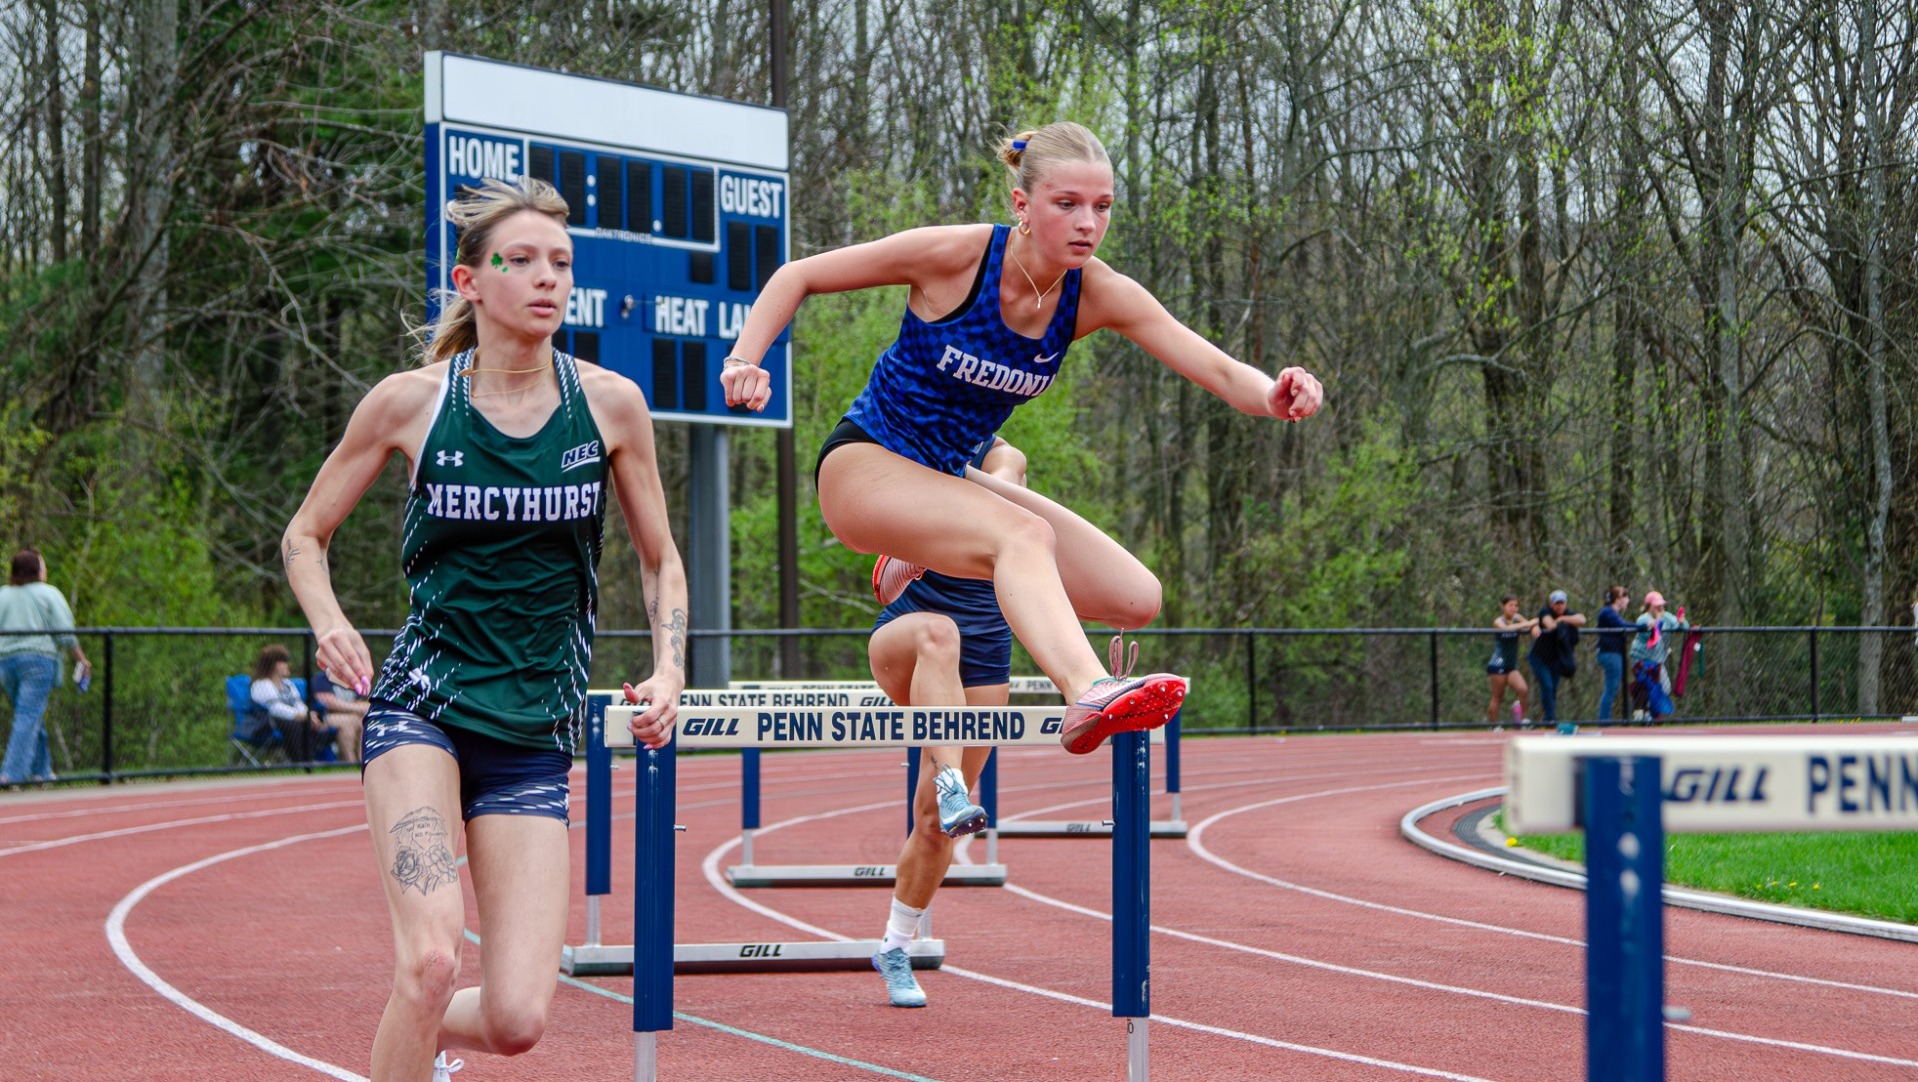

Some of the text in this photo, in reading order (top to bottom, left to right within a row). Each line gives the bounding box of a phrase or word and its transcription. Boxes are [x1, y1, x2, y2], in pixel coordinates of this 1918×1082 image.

[449, 135, 519, 183] HOME
[720, 175, 783, 218] GUEST
[564, 287, 607, 327] ENT
[655, 295, 709, 336] HEAT
[936, 344, 1056, 397] FREDONI
[561, 440, 599, 468] NEC
[426, 481, 601, 522] MERCYHURST
[679, 693, 712, 706] ENN
[718, 693, 767, 706] STATE
[772, 693, 850, 706] BEHREND
[682, 718, 740, 736] GILL
[757, 711, 823, 741] PENN
[831, 711, 904, 741] STATE
[912, 711, 1025, 741] BEHREND
[1663, 766, 1769, 802] GILL
[854, 867, 885, 876] GILL
[739, 944, 782, 957] GILL
